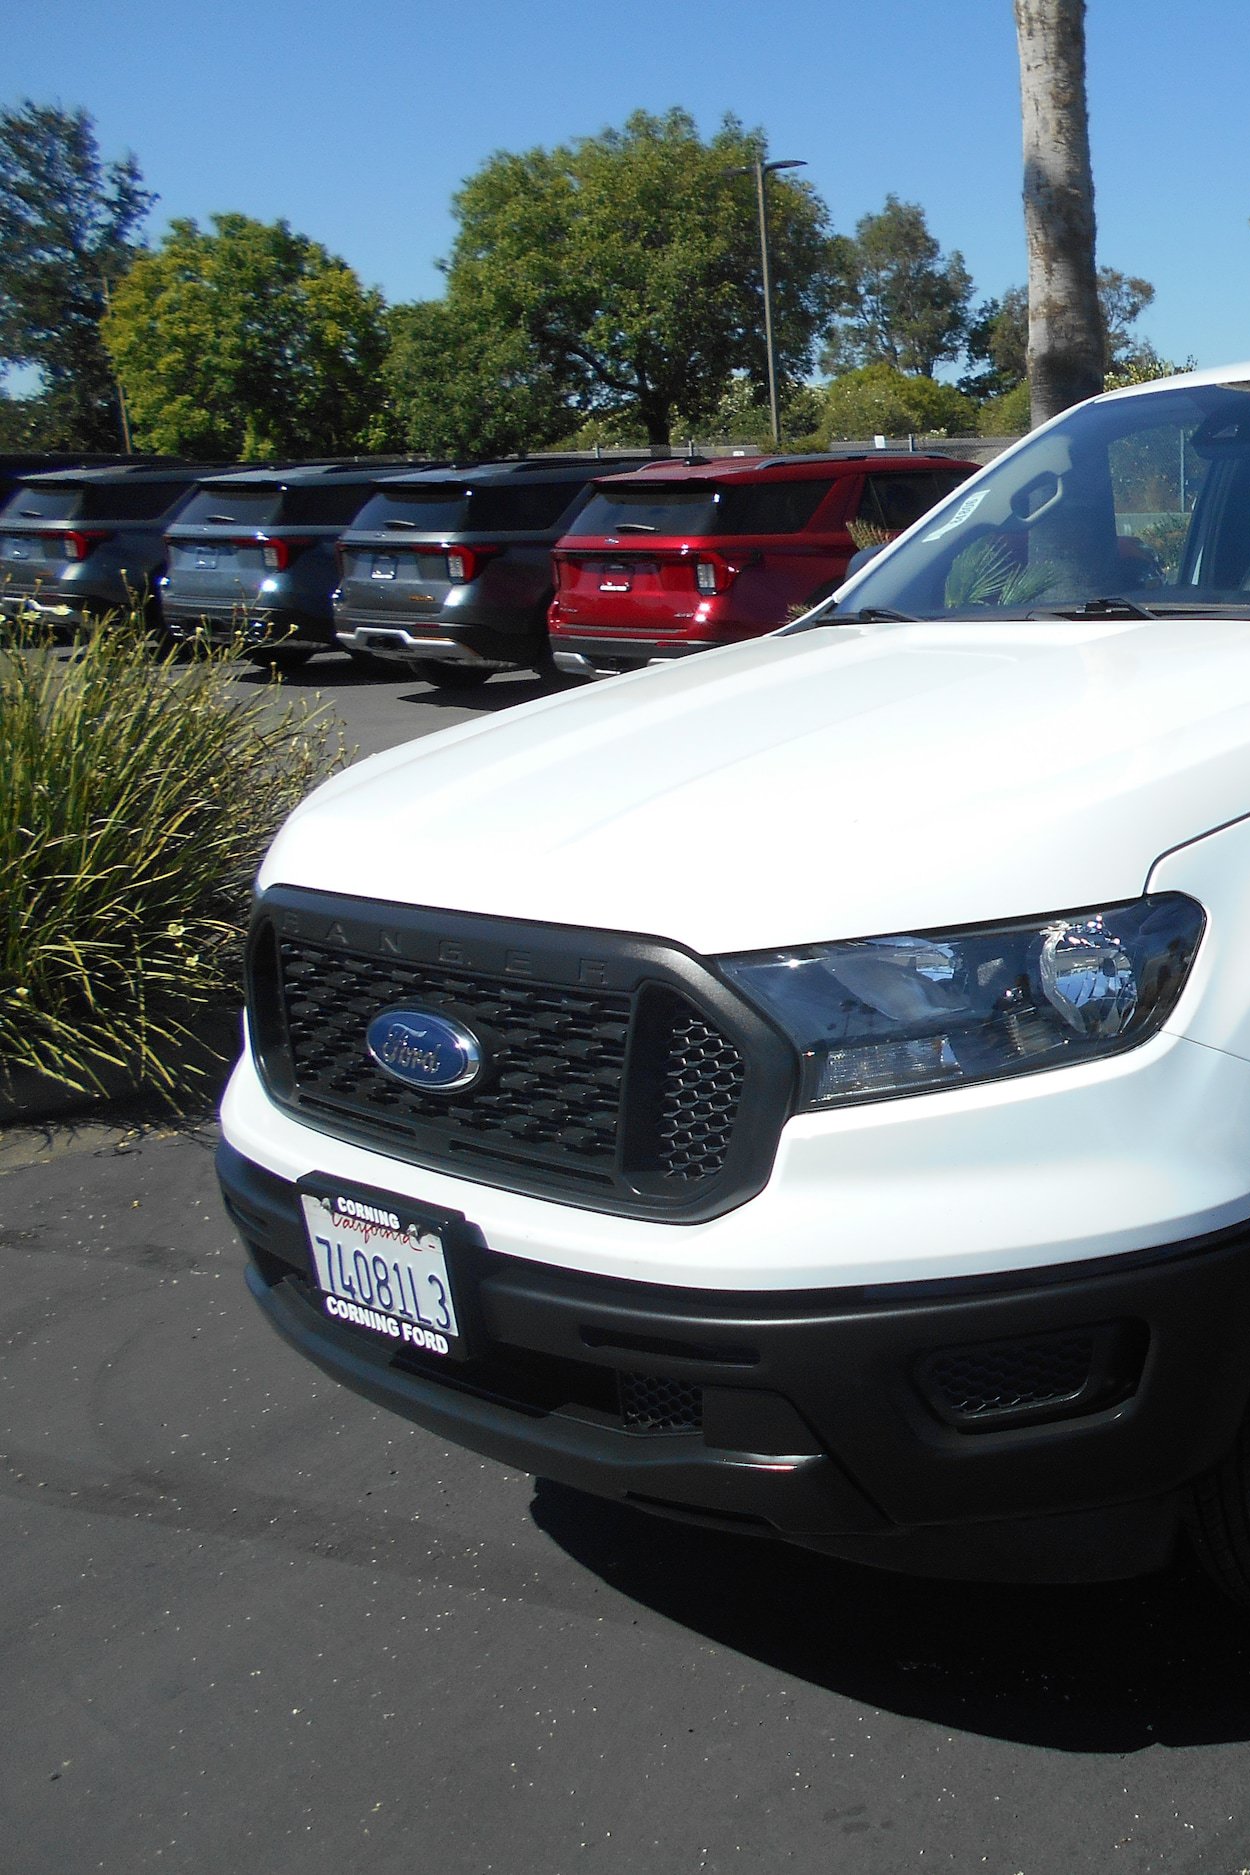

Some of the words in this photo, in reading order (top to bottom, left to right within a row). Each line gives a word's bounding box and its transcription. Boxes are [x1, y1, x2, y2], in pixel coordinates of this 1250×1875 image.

[281, 911, 609, 986] RANGER
[383, 1023, 441, 1074] Ford
[337, 1196, 401, 1230] CORNING
[315, 1236, 451, 1330] 74081L3
[326, 1296, 401, 1337] CORNING
[402, 1322, 449, 1355] FORD
